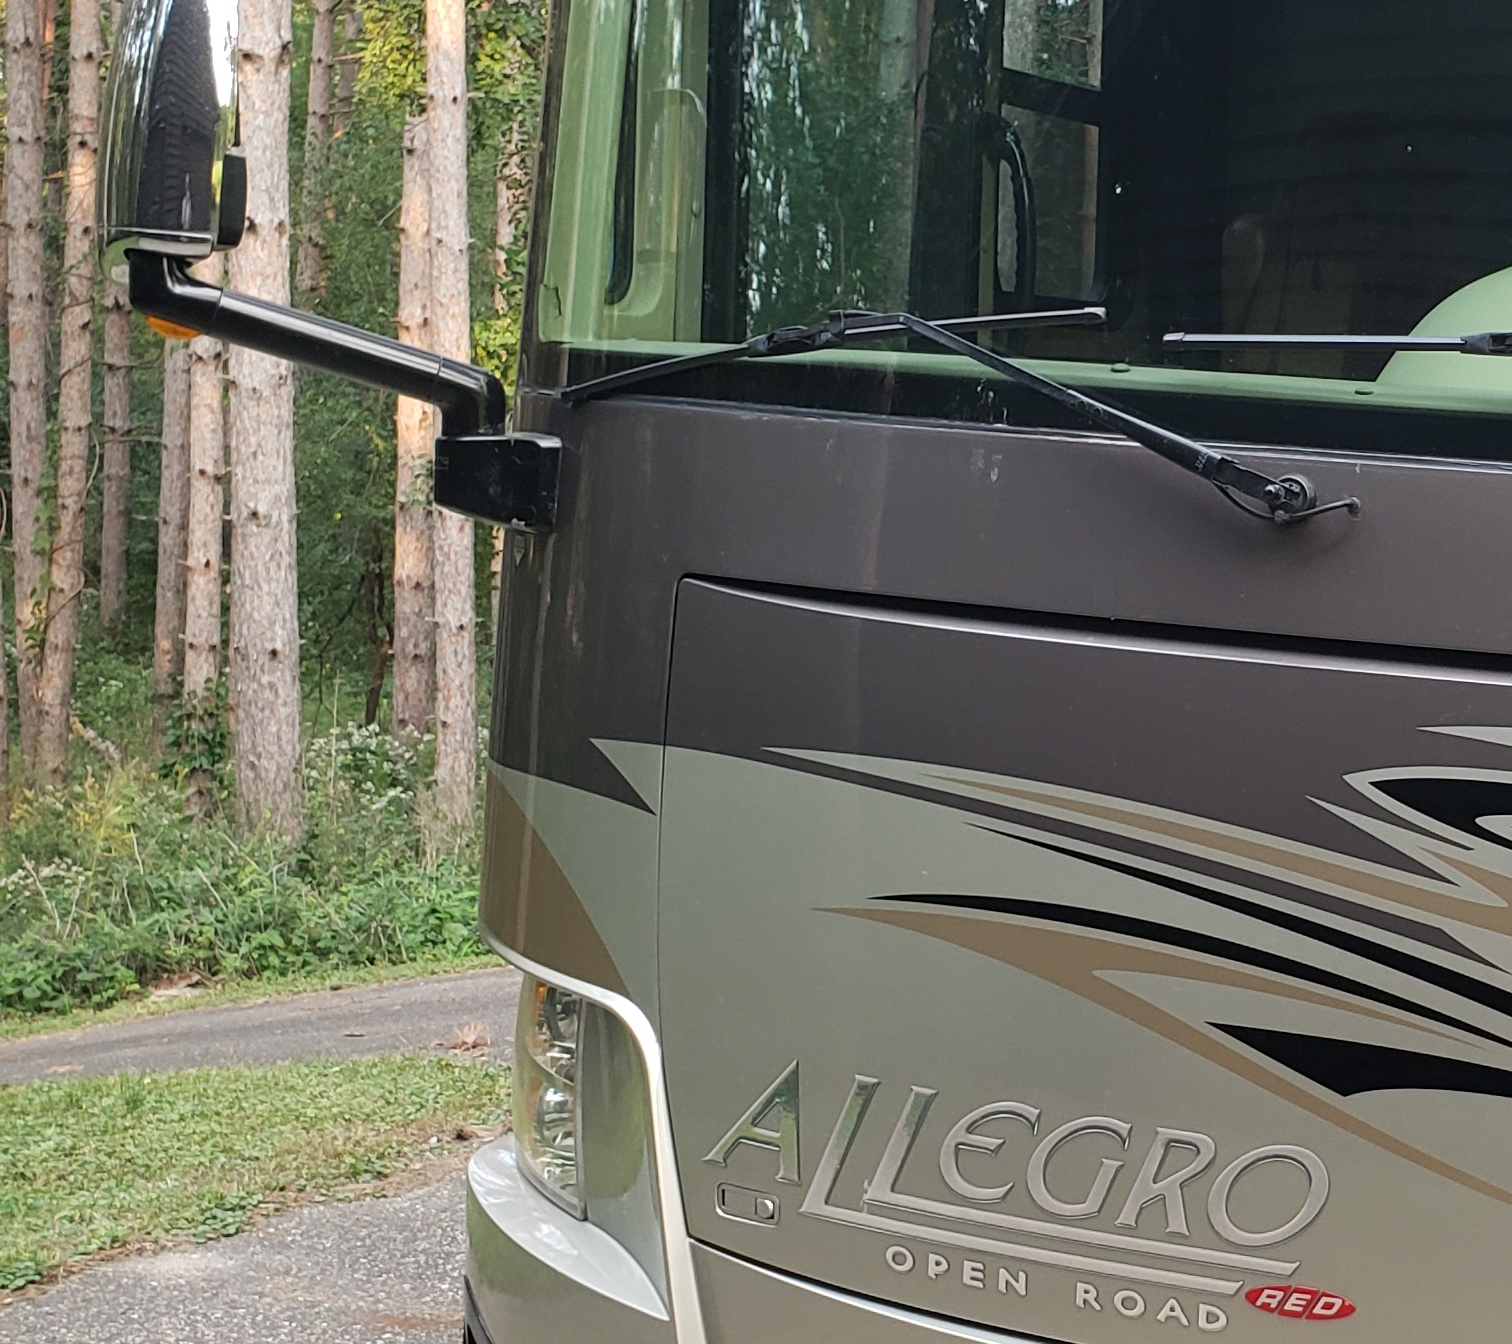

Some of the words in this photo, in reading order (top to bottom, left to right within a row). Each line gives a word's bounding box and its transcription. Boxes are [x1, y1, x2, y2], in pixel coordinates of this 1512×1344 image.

[701, 1058, 1331, 1249] ALLEGRO
[885, 1245, 1029, 1297] OPEN
[1074, 1281, 1230, 1333] ROAD
[1255, 1288, 1344, 1318] RED
